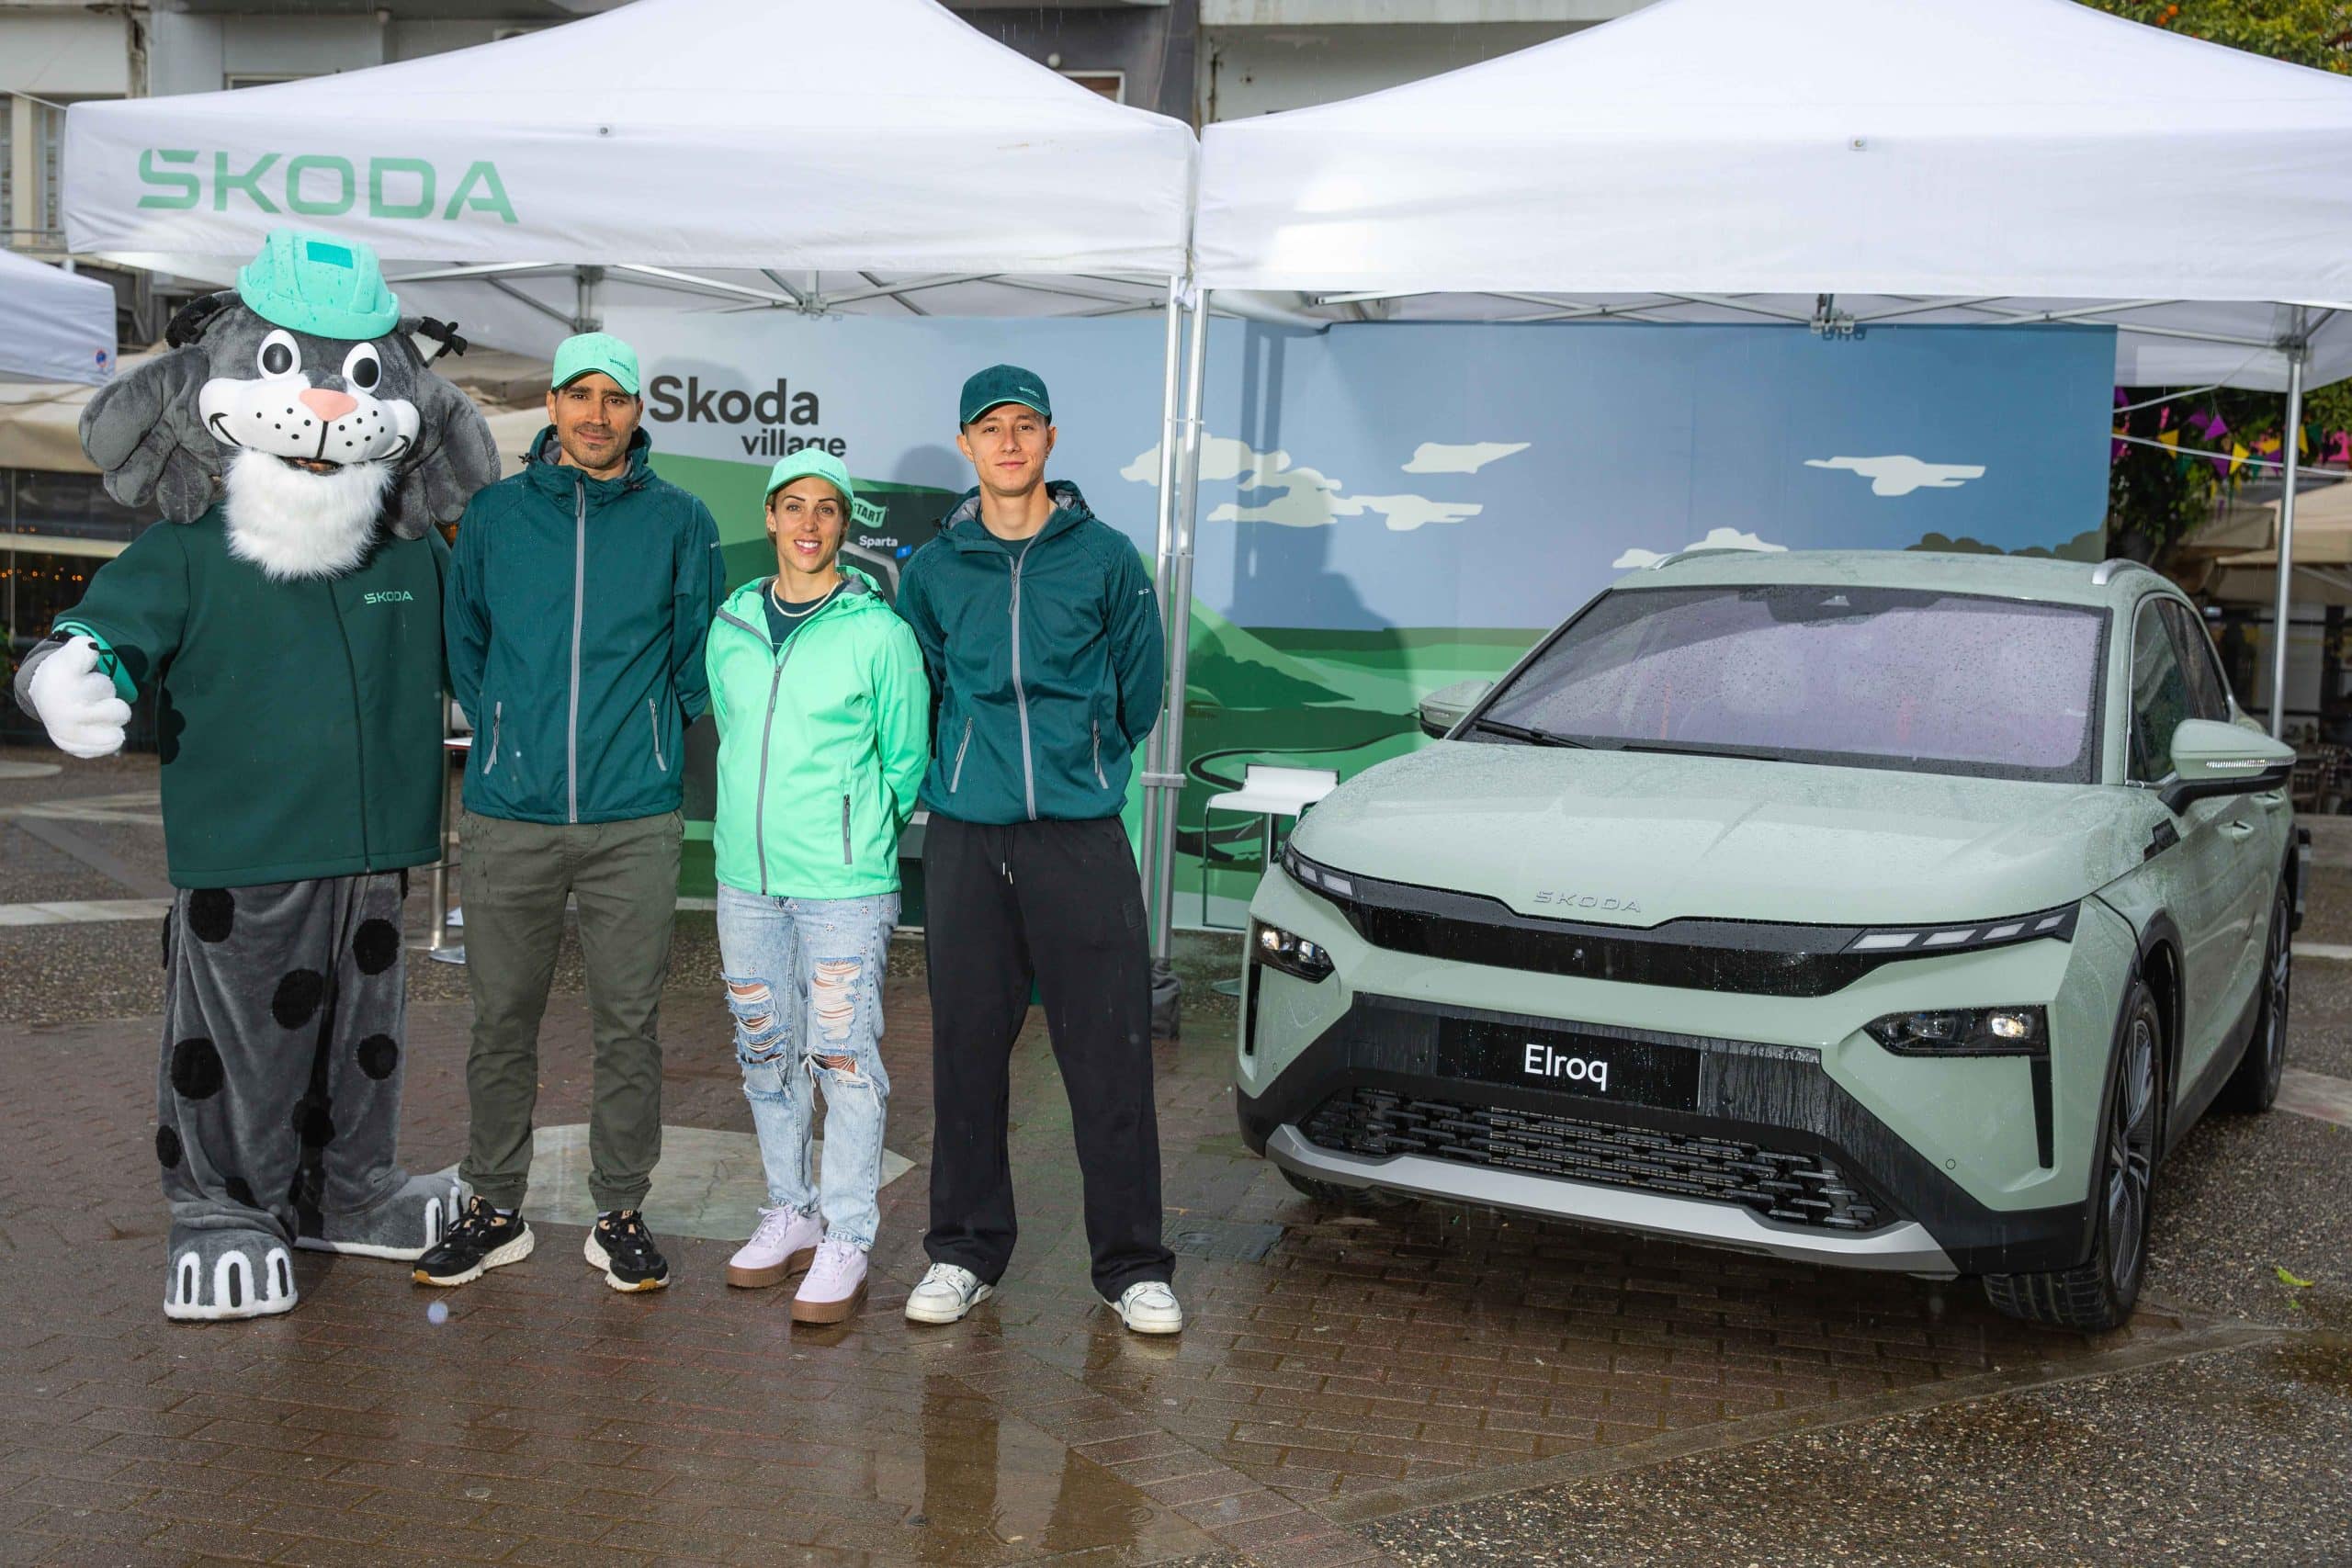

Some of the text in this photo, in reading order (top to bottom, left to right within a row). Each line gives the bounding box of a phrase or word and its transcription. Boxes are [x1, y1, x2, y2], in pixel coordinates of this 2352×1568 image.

[137, 148, 520, 224] SKODA
[649, 375, 820, 425] Skoda
[854, 502, 884, 523] TART
[859, 536, 899, 549] Sparta
[364, 591, 414, 604] SKODA
[1533, 890, 1642, 913] SKODA
[1524, 1043, 1609, 1092] Elroq
